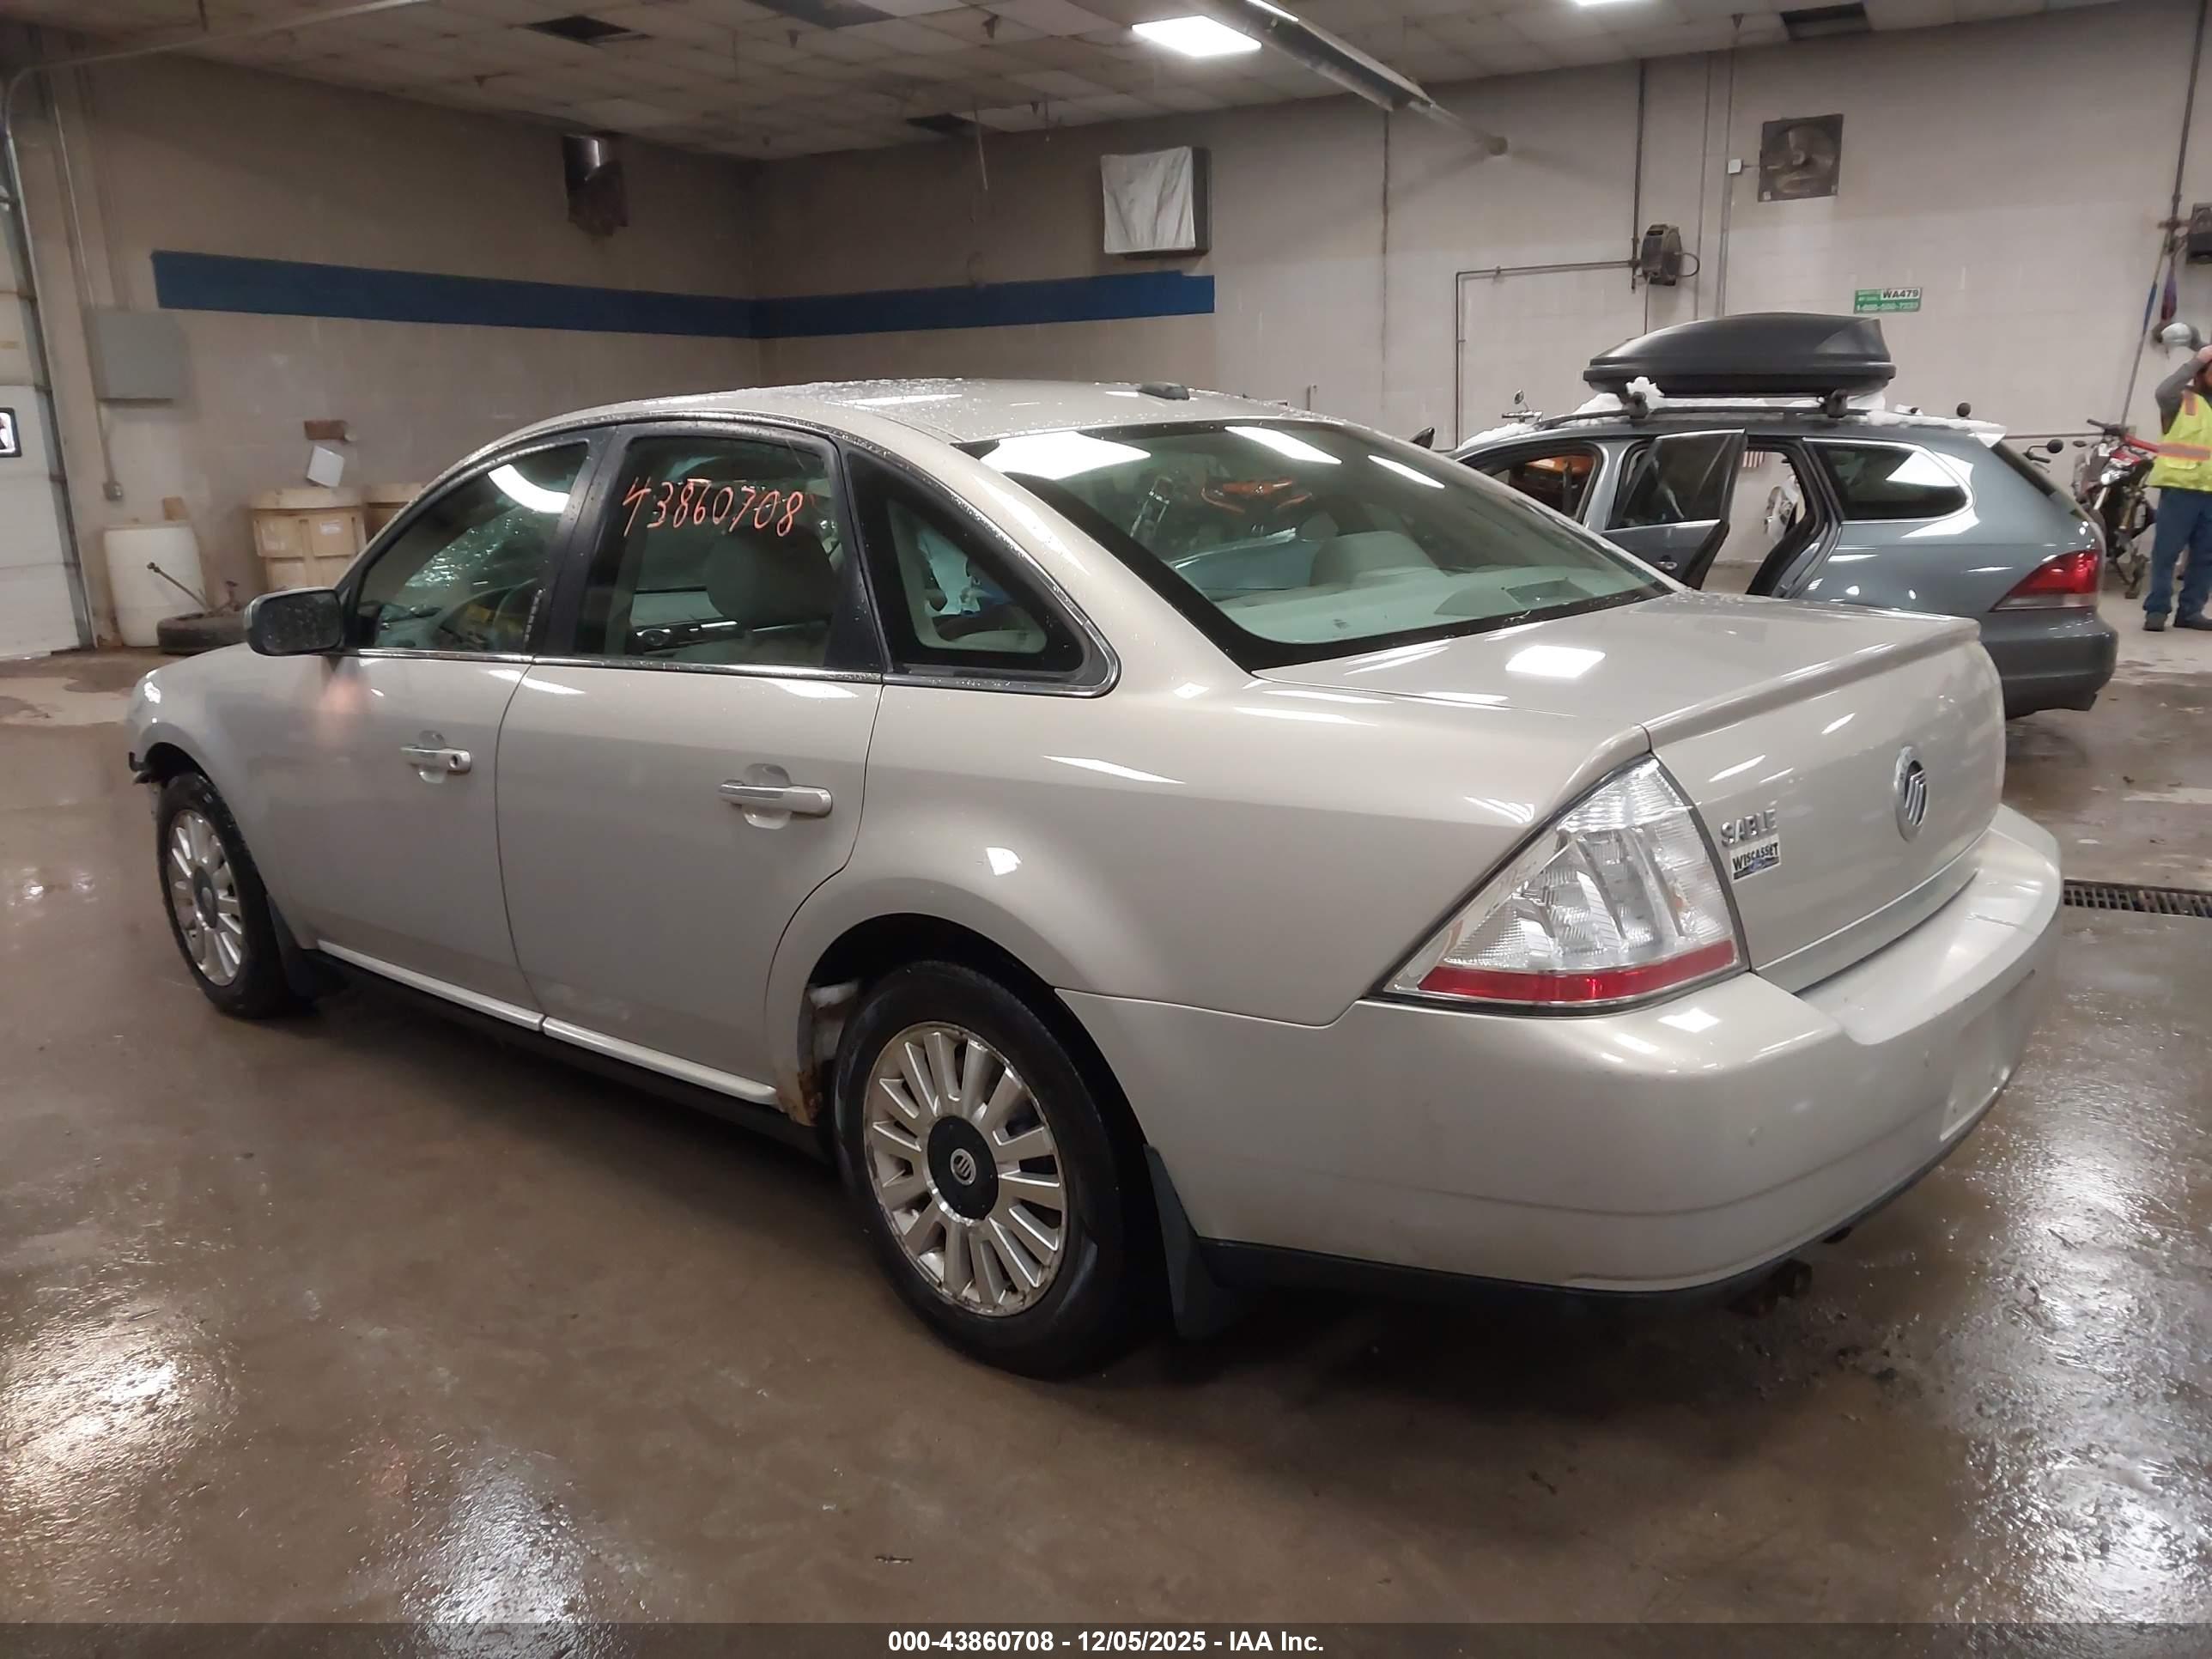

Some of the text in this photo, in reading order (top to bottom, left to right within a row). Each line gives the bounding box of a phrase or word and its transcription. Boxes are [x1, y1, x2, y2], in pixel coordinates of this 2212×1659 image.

[623, 477, 804, 538] 43860708
[1721, 808, 1777, 848] SABLE
[1733, 842, 1778, 871] WISCASSET
